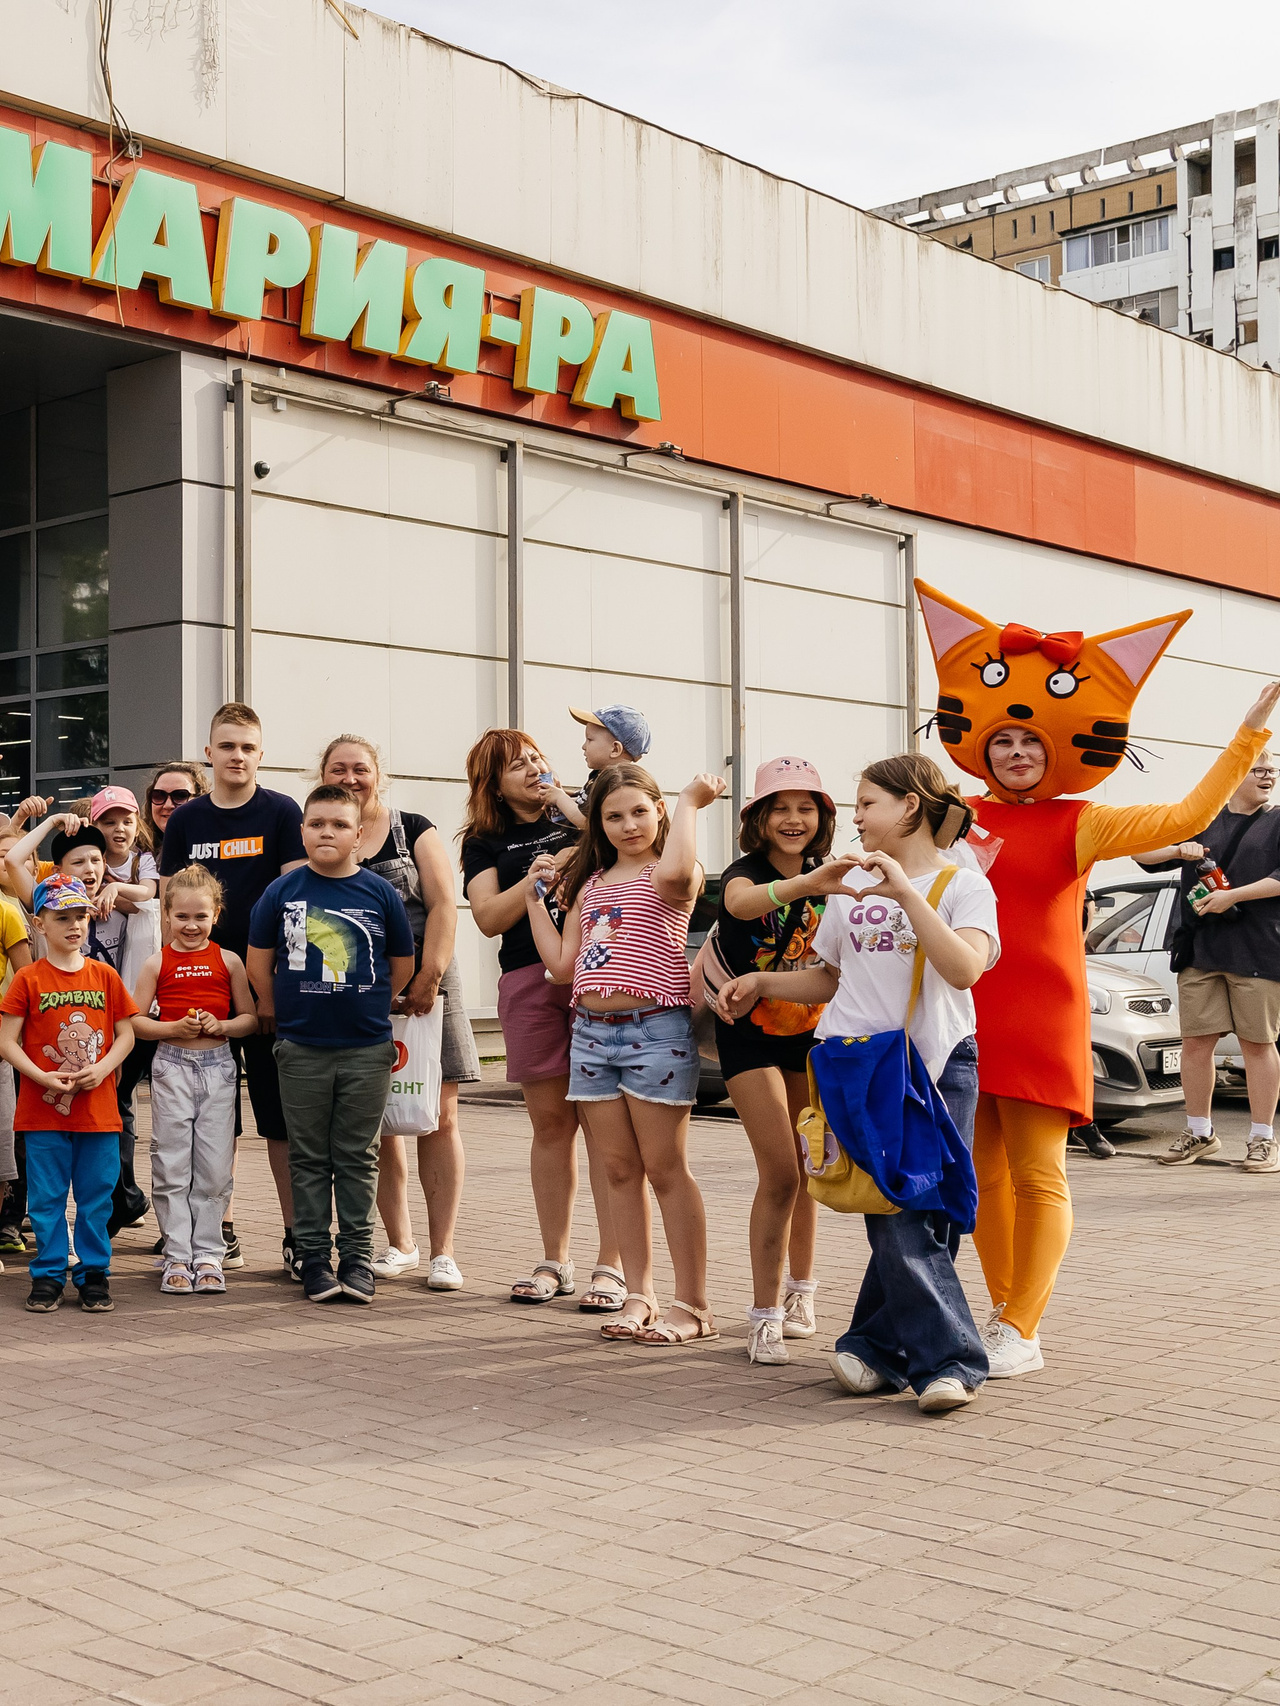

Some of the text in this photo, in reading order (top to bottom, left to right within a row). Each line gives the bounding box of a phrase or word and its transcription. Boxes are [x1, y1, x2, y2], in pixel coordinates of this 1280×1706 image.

[188, 840, 262, 860] JUST CHILL.
[848, 904, 902, 925] GO
[185, 970, 213, 978] Paris?
[1164, 1052, 1181, 1069] E75
[391, 1080, 424, 1095] ант
